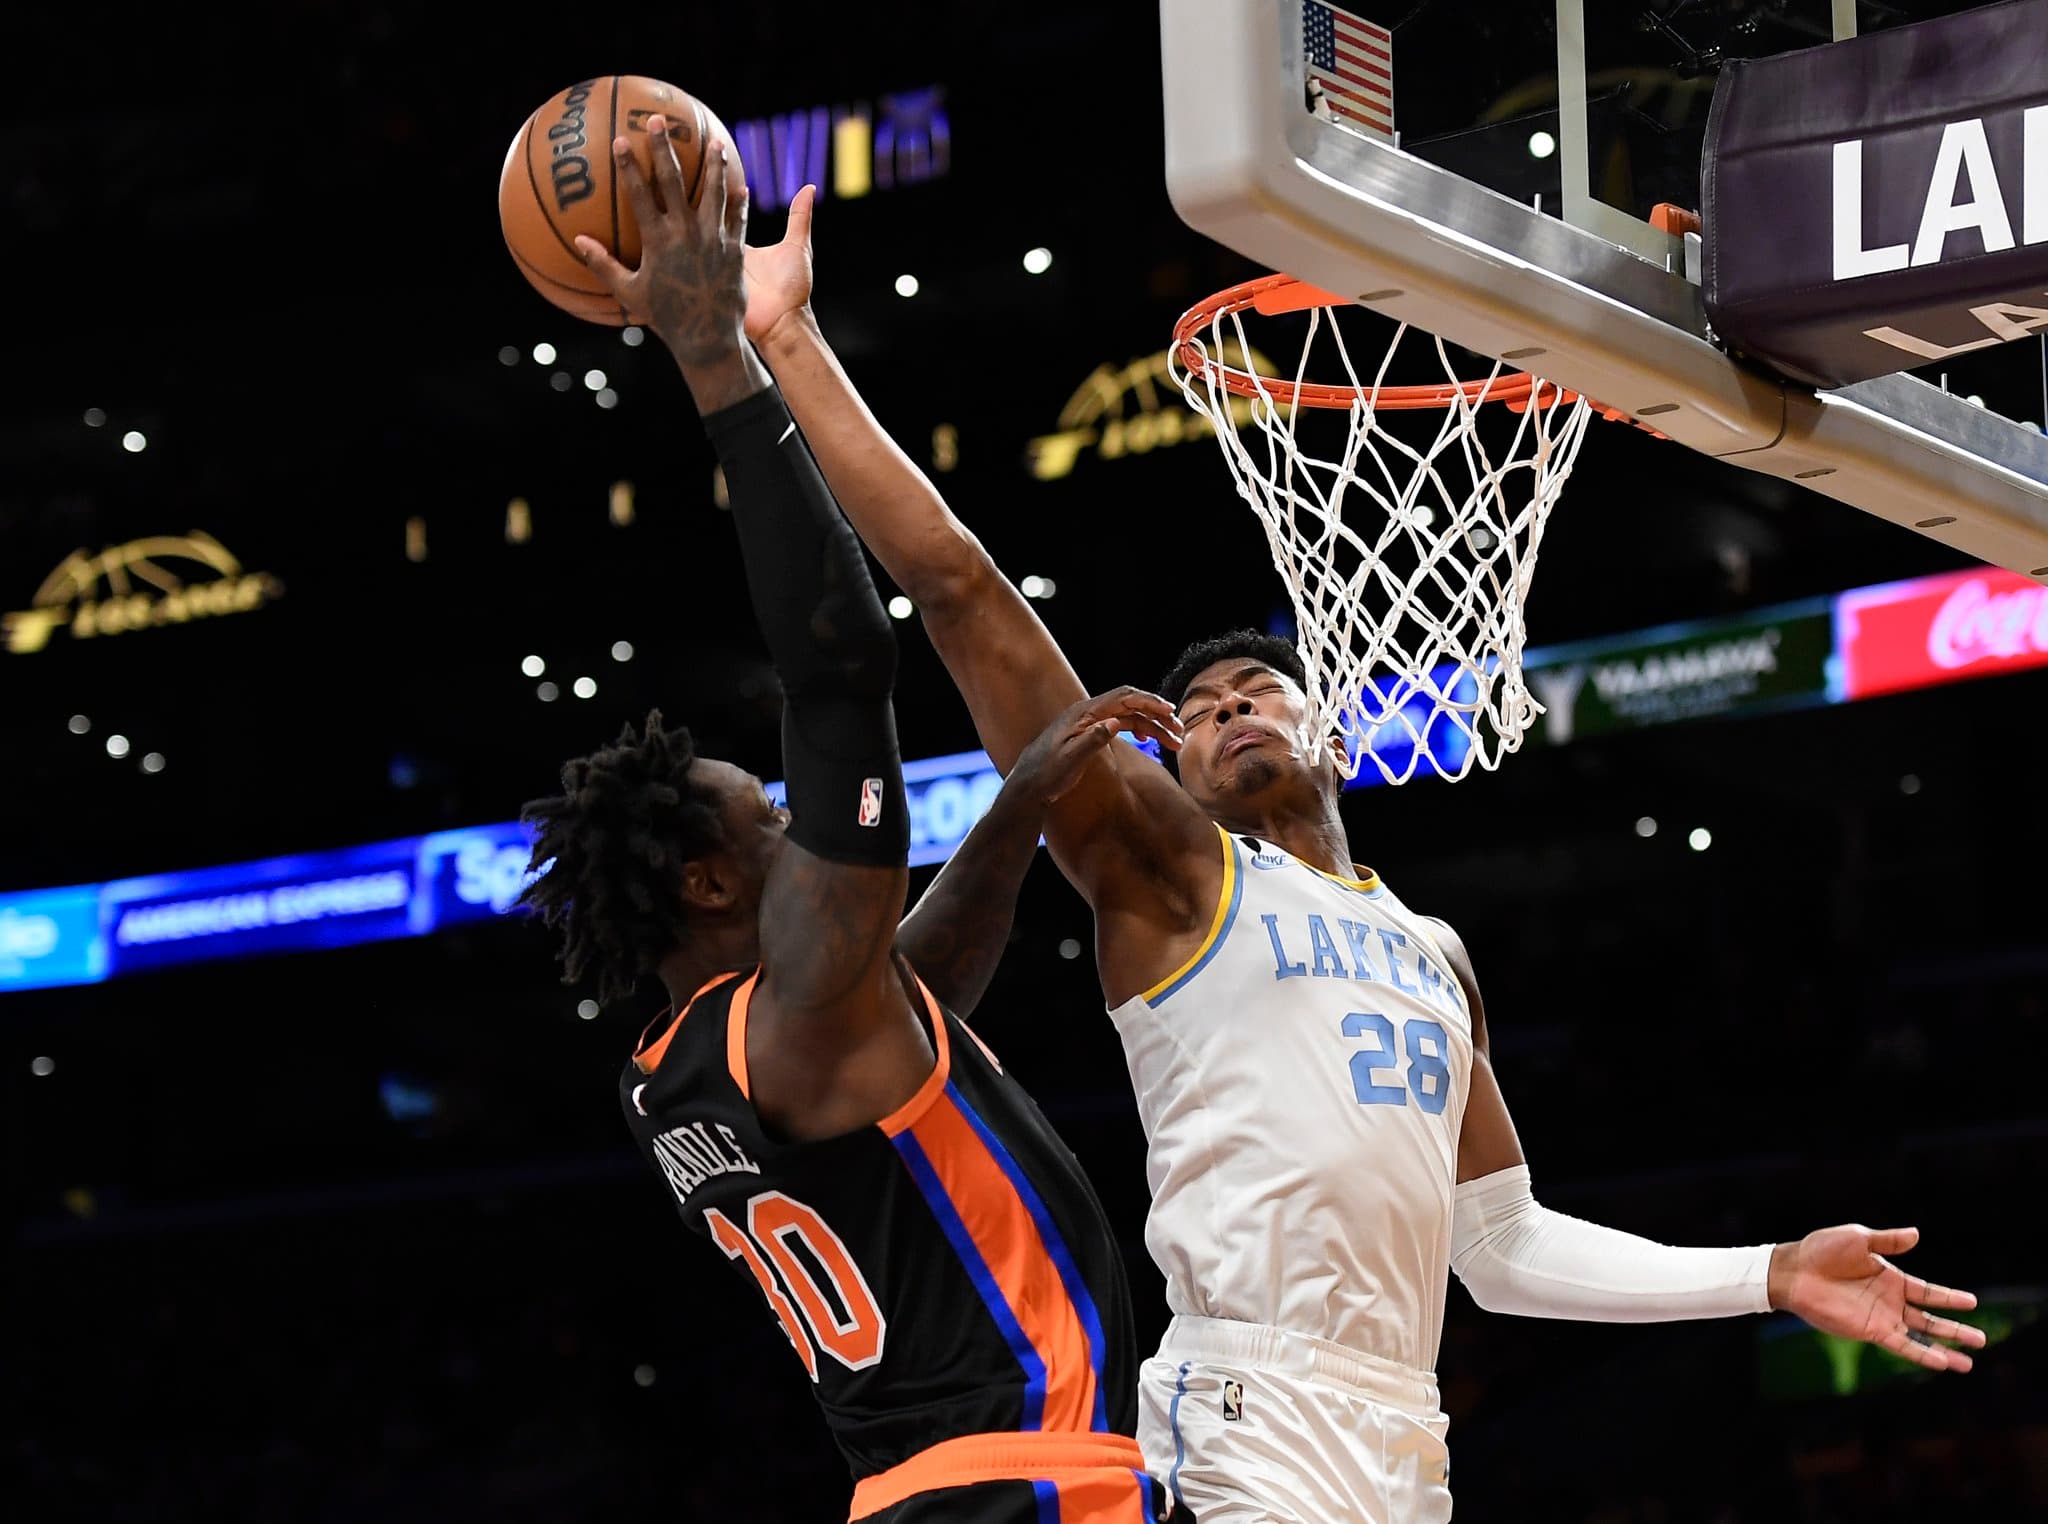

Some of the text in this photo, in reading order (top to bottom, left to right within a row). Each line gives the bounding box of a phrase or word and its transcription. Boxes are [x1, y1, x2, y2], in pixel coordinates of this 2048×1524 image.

[1862, 291, 2048, 360] LA
[1341, 1012, 1450, 1115] 28
[653, 1121, 760, 1204] RANDLE
